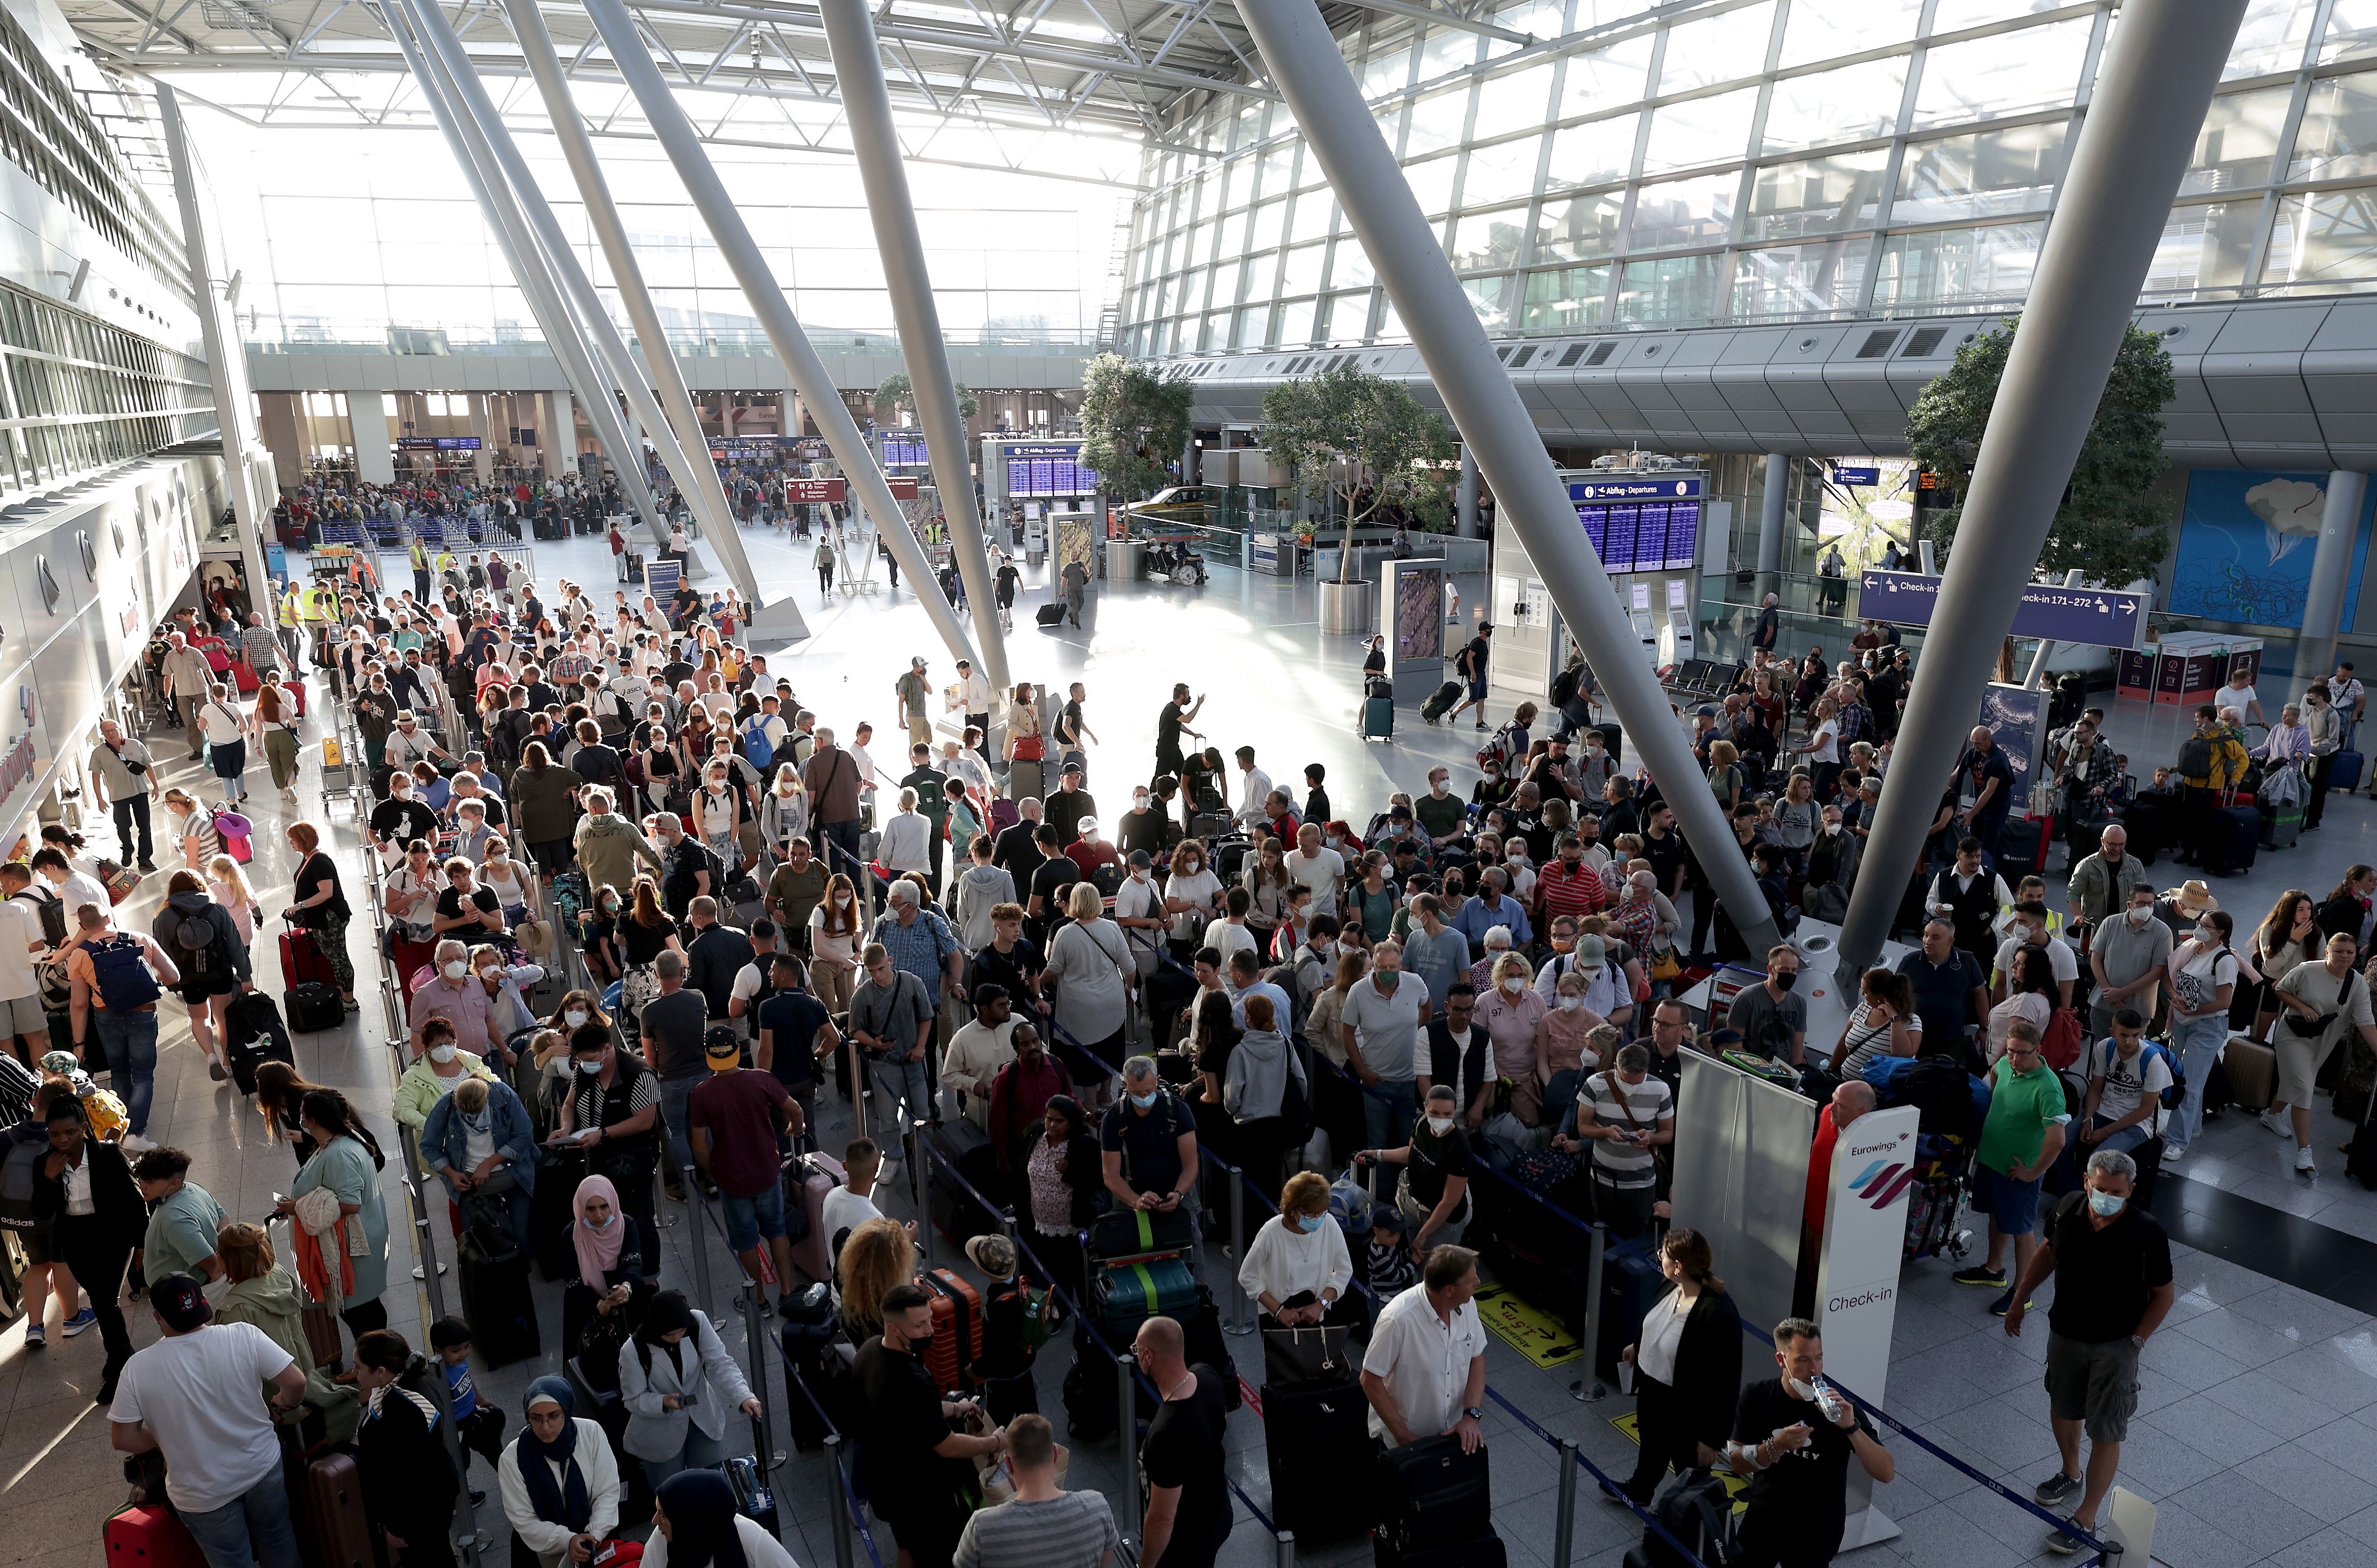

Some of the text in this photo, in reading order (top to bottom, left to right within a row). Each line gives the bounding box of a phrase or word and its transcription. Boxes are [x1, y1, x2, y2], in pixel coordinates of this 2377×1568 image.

[1607, 485, 1657, 496] Abflug Departures
[1900, 582, 1934, 593] Check-in
[2022, 594, 2050, 604] eck-in
[627, 685, 642, 694] asics
[1517, 820, 1532, 832] PUMA
[1491, 1007, 1502, 1017] 97
[1851, 1142, 1897, 1156] Eurowings
[1, 1217, 35, 1227] adidas
[1829, 1287, 1892, 1312] Check-in
[1514, 1321, 1537, 1337] 1,5
[1498, 1324, 1532, 1348] Abstand
[1888, 1419, 1901, 1432] DUS
[1538, 1428, 1549, 1441] DUS
[1988, 1480, 2004, 1494] DUS
[1622, 1494, 1633, 1509] DUS
[861, 1529, 870, 1541] DUS
